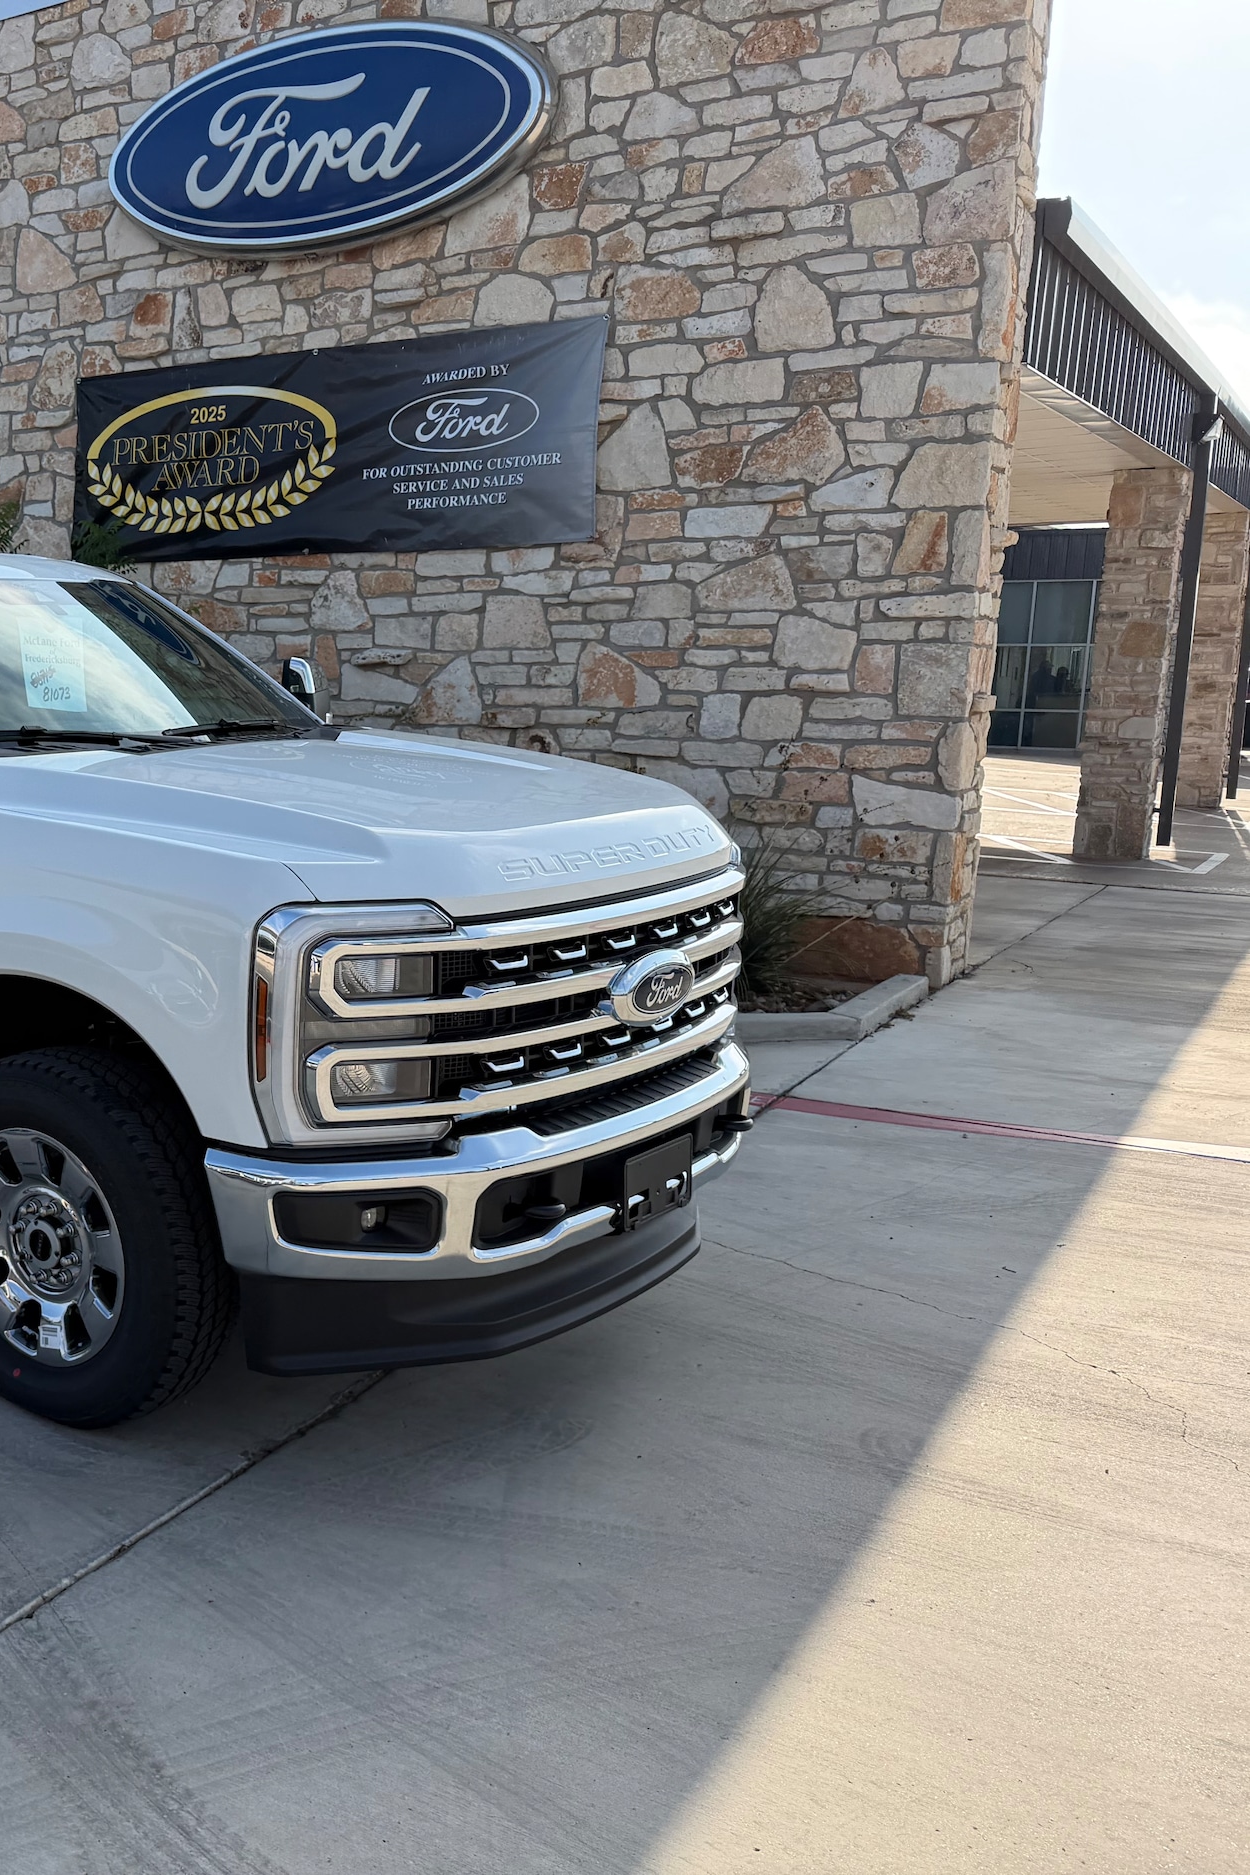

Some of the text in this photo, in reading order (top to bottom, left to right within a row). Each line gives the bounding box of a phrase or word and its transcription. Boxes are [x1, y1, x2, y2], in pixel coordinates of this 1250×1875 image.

[185, 72, 431, 209] Ford
[422, 364, 510, 385] AWARDED BY
[190, 405, 227, 425] 2025
[414, 396, 510, 443] Ford
[111, 420, 314, 466] PRESIDENT'S
[151, 455, 260, 491] AWARD
[362, 452, 562, 480] FOR OUTSTANDING CUSTOMER
[392, 473, 524, 494] SERVICE AND SALES
[407, 492, 507, 510] PERFORMANCE
[43, 686, 71, 702] 81073
[497, 825, 717, 882] SUPER DUTY
[646, 972, 684, 1007] Ford
